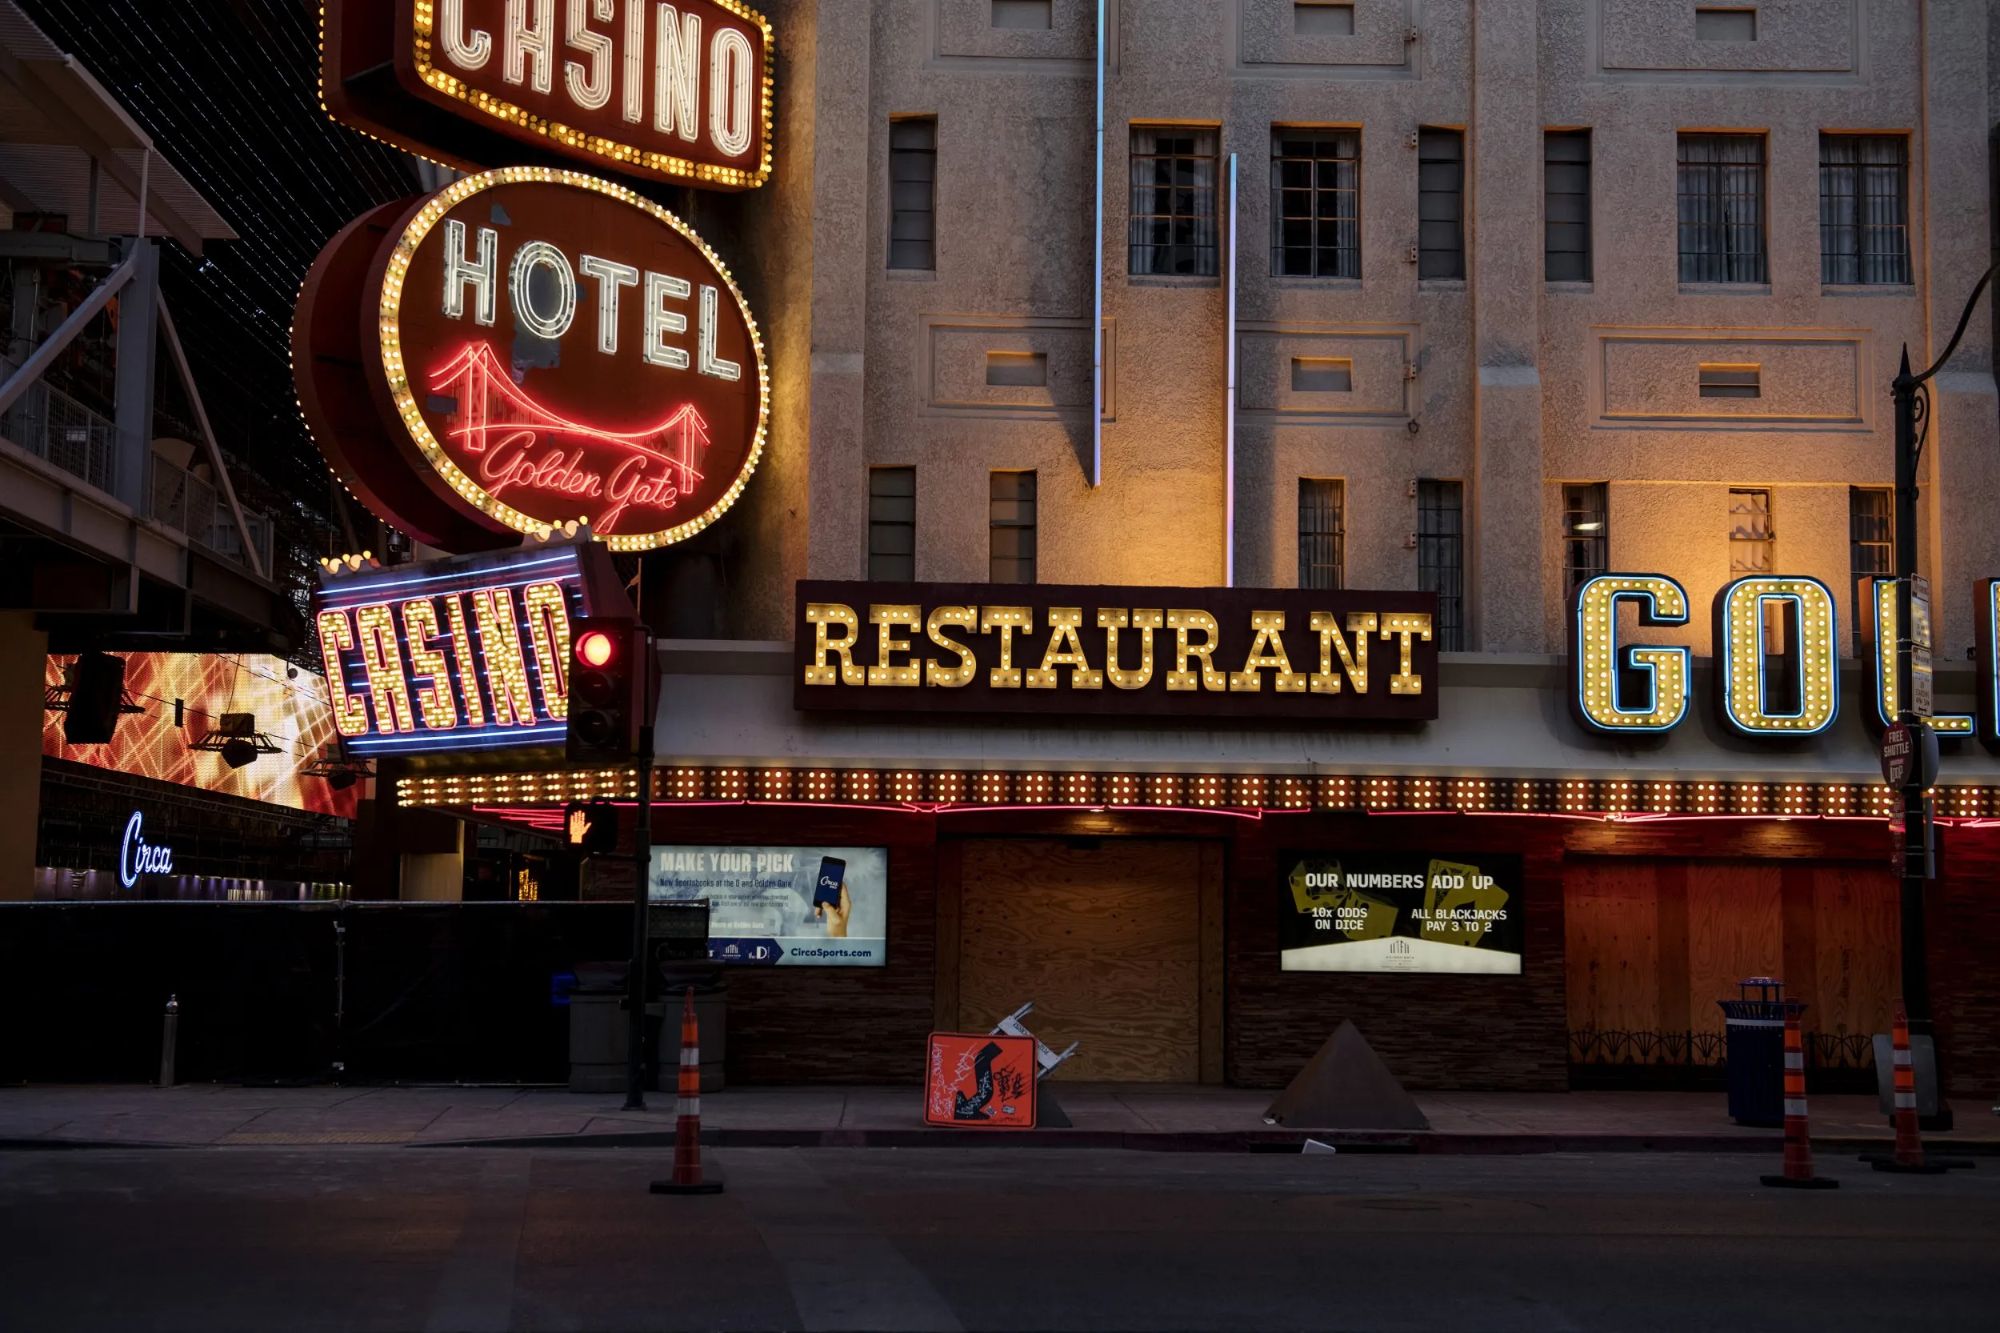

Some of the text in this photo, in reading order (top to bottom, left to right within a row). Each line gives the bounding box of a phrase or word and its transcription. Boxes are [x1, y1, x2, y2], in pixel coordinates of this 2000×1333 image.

[442, 218, 741, 381] HOTEL
[480, 430, 678, 533] Golden Gate
[804, 602, 1432, 696] RESTAURANT
[1570, 573, 2000, 739] GOL
[317, 580, 570, 736] CASINO
[1889, 730, 1904, 743] FREE
[1884, 742, 1910, 757] SHUTTLE
[120, 810, 173, 889] Circa
[661, 853, 794, 872] MAKE YOUR PICK
[723, 879, 734, 887] the
[1305, 873, 1494, 890] OUR NUMBERS ADD UP
[1312, 908, 1368, 918] 10x ODDS
[1412, 909, 1507, 920] ALL BLACKJACKS
[1315, 920, 1364, 930] ON DICE
[1426, 921, 1493, 932] PAY 3 TO 2
[791, 947, 871, 958] CircaSports.com
